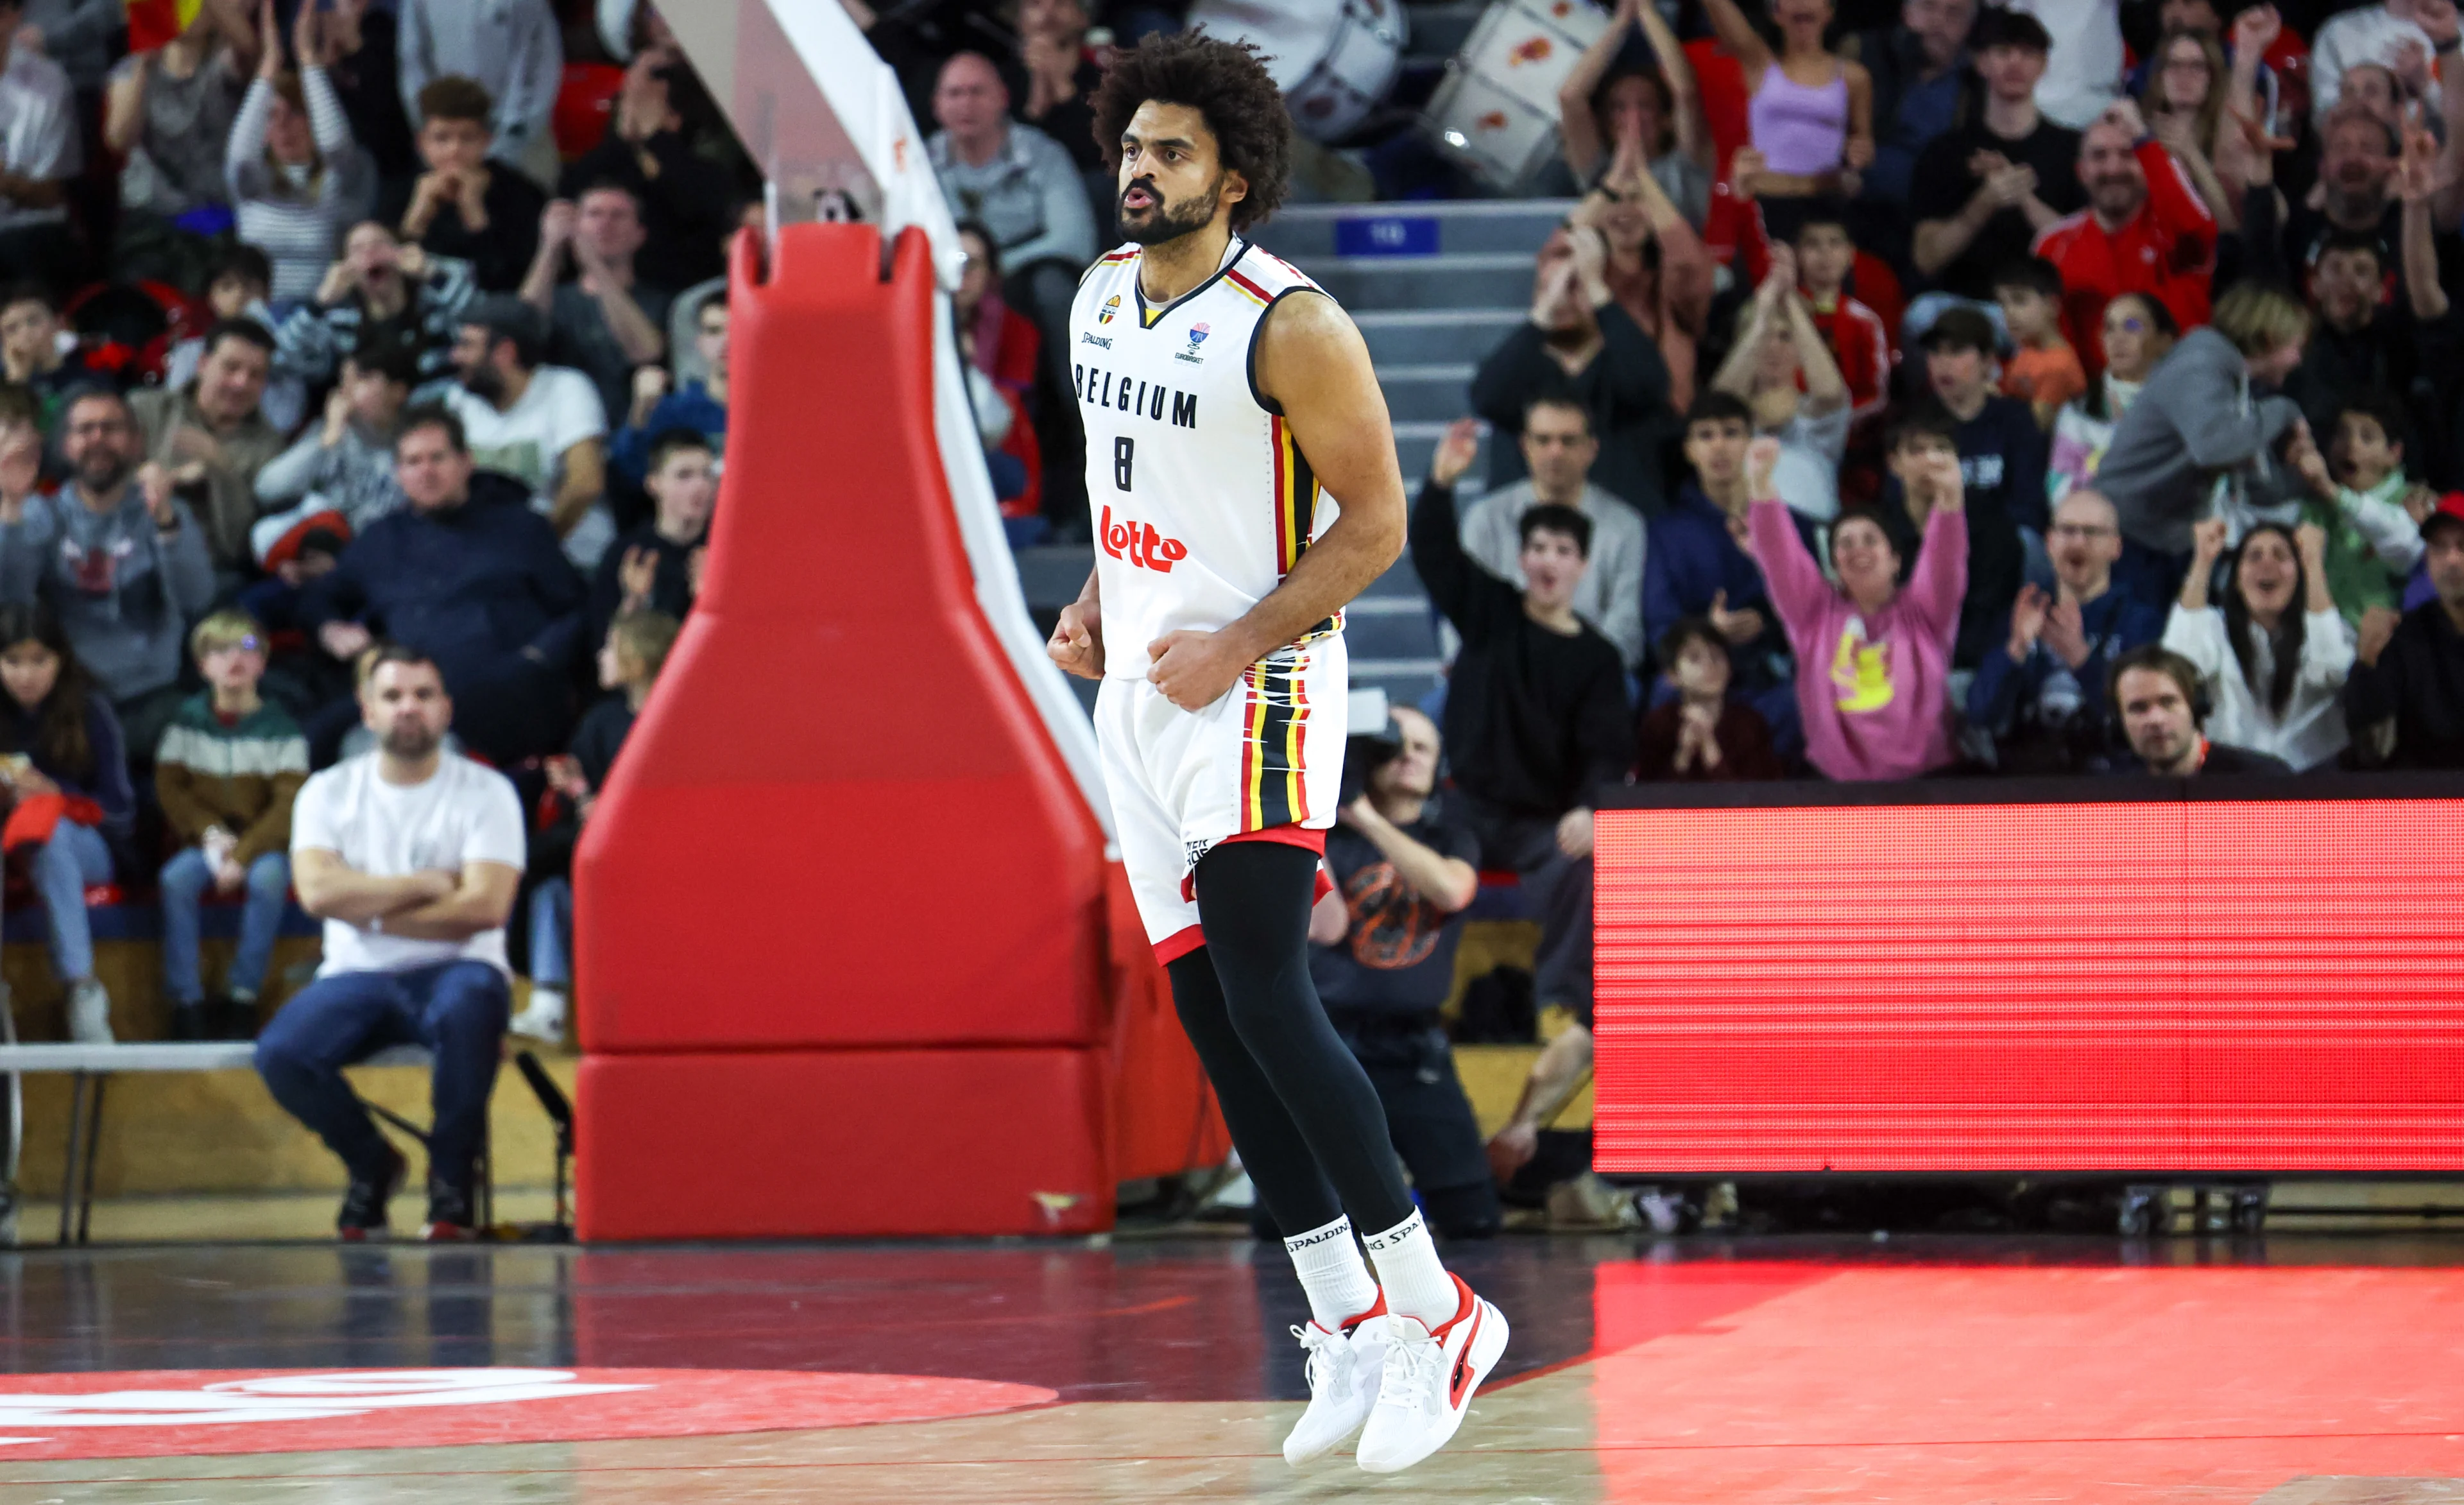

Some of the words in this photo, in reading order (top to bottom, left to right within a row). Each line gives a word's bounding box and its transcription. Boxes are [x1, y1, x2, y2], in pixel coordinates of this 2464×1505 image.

[1081, 331, 1113, 350] SPALDING
[1174, 352, 1204, 365] EUROBASKET
[1075, 363, 1197, 429] BELGIUM
[1115, 436, 1134, 492] 8
